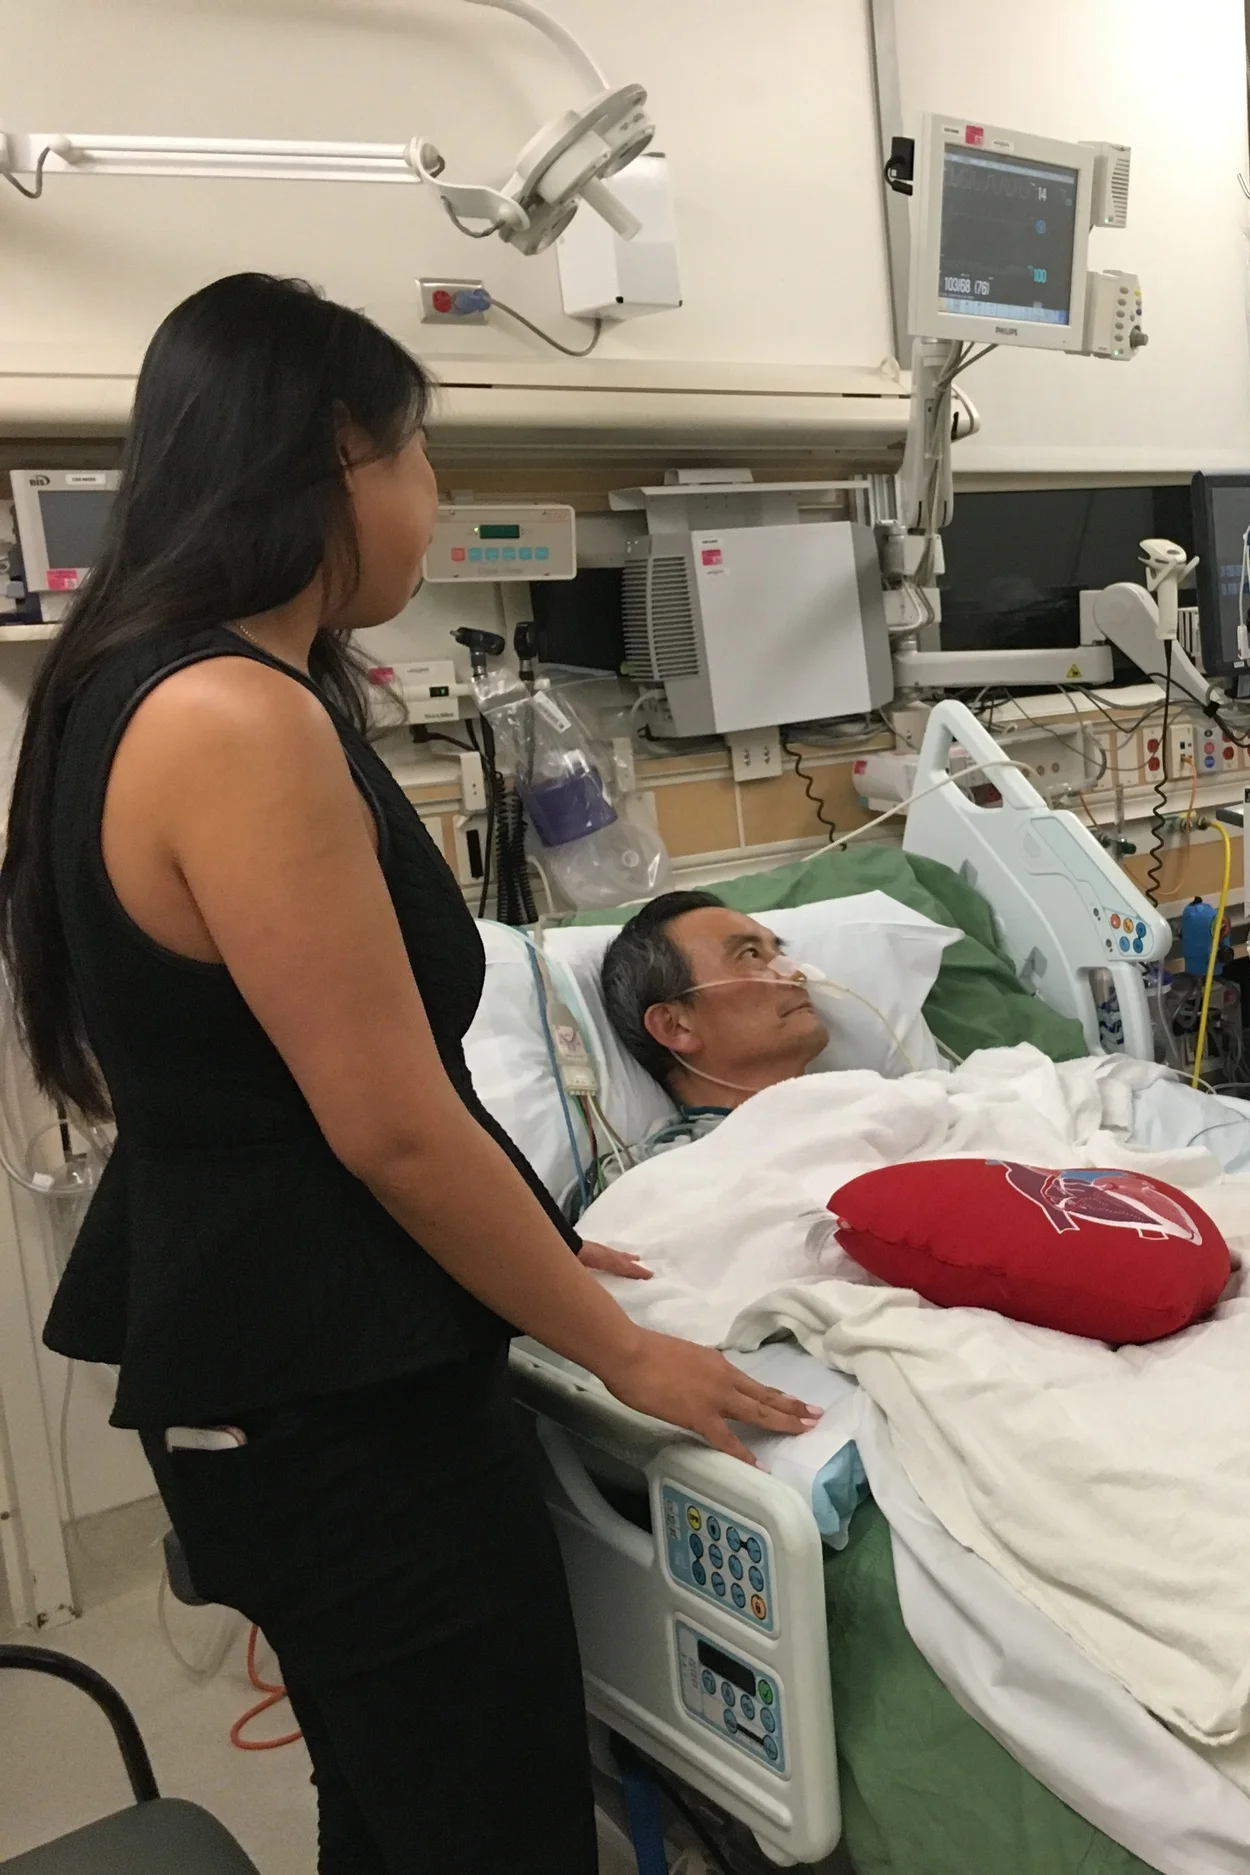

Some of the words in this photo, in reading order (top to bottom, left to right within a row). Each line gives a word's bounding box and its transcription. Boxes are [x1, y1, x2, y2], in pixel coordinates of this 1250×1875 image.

[1033, 268, 1047, 283] 100
[974, 280, 990, 296] (76)
[995, 326, 1018, 336] PHILIPS
